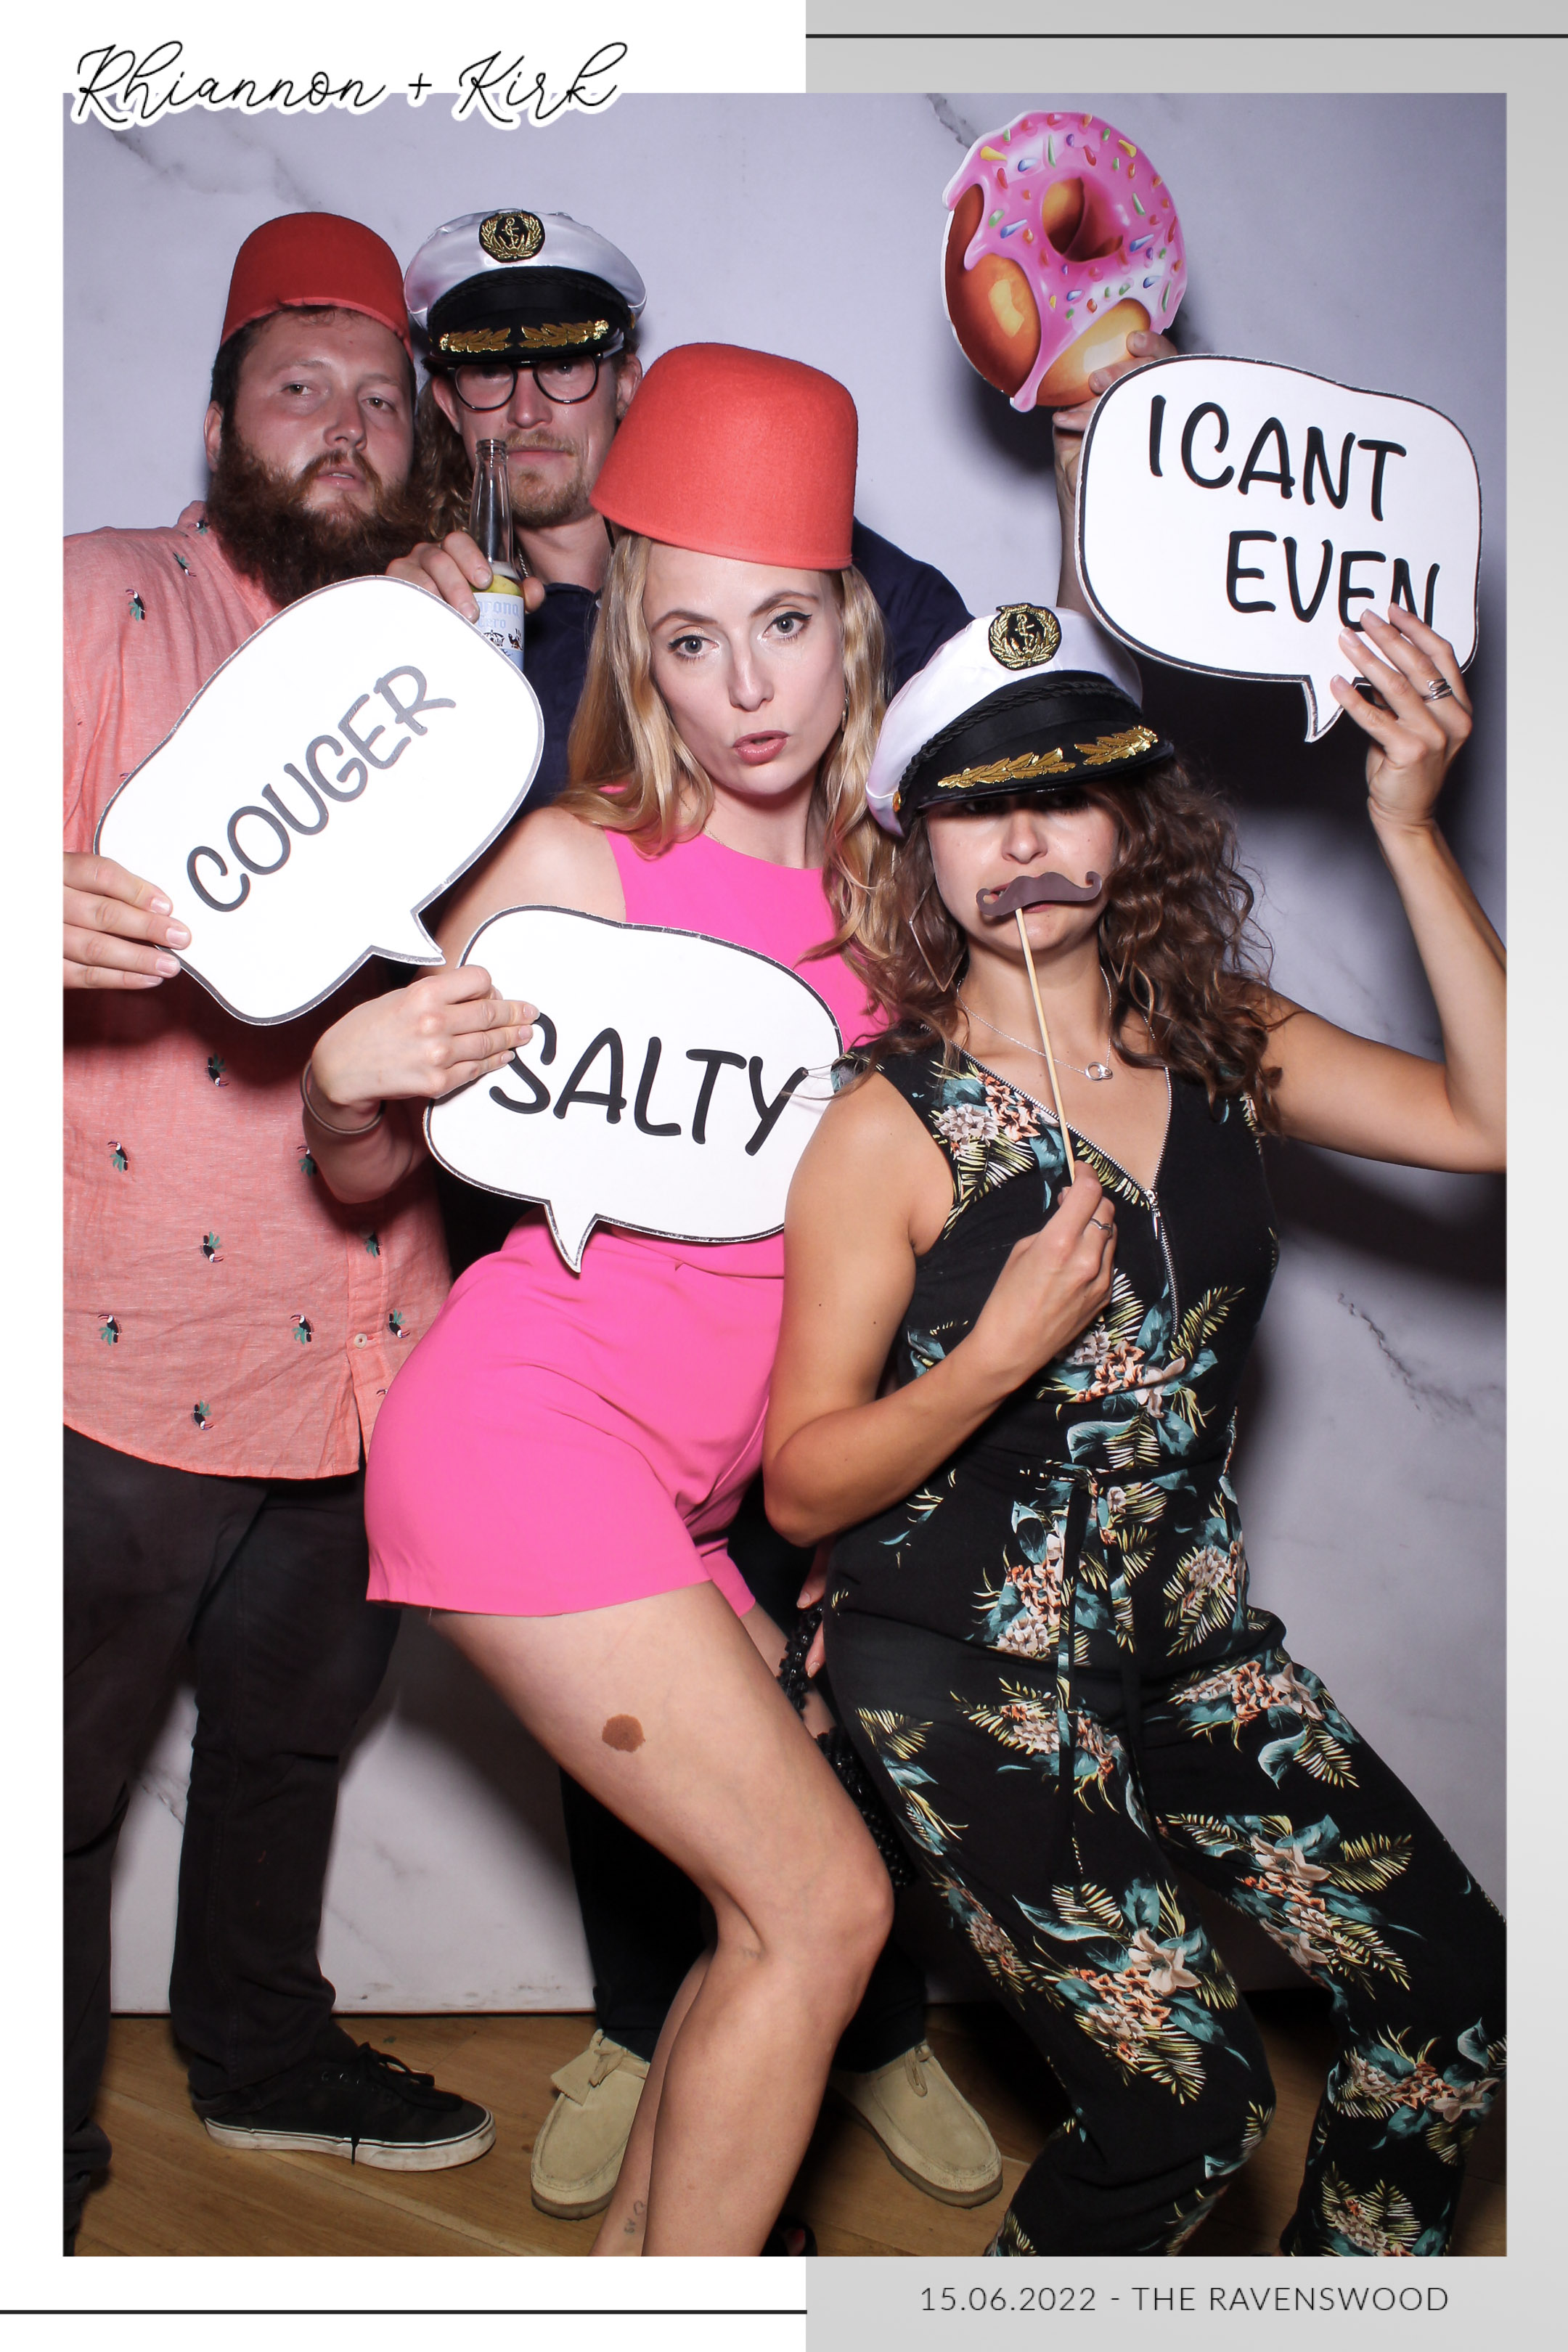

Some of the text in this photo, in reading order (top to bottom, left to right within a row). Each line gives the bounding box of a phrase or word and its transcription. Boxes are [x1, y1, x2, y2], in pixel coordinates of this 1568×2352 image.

[1149, 395, 1407, 522] I CANT
[1226, 530, 1440, 634] EVEN
[187, 665, 457, 912] COUGER
[489, 1011, 809, 1156] SALTY
